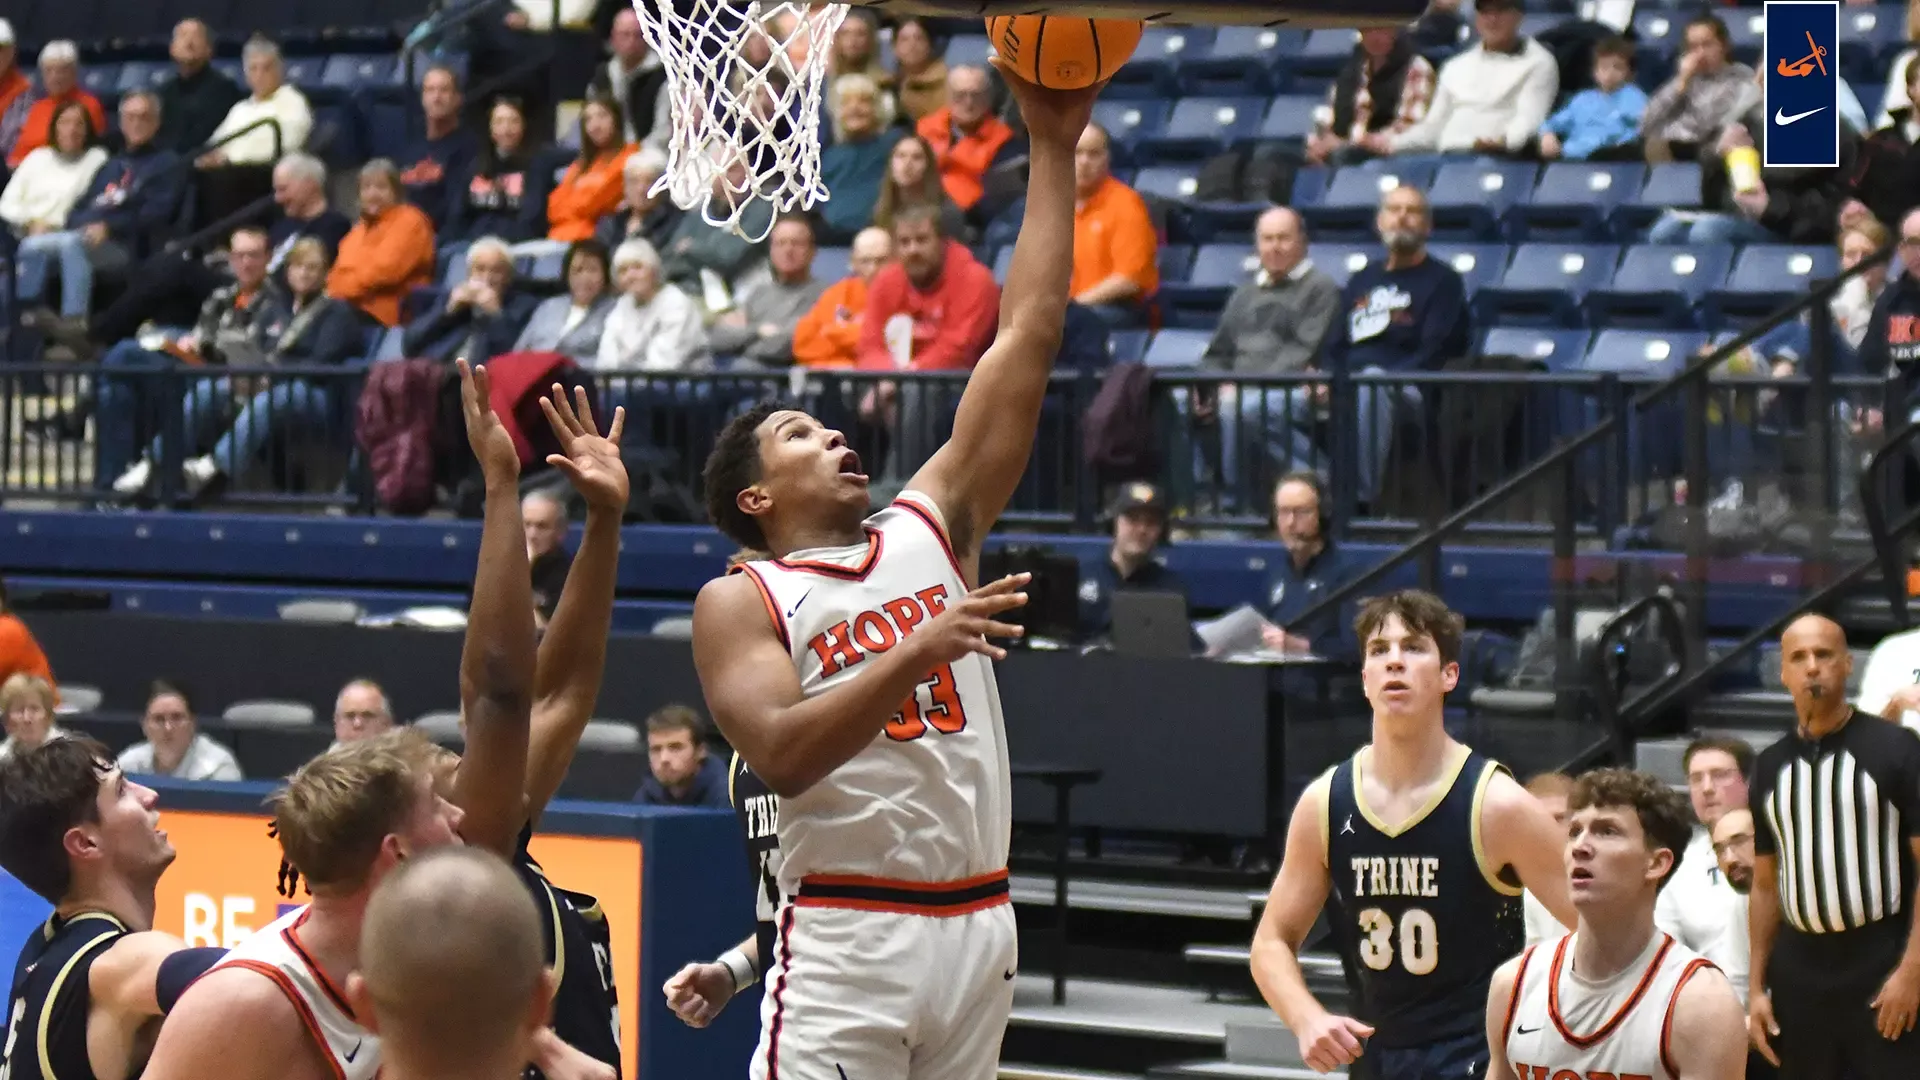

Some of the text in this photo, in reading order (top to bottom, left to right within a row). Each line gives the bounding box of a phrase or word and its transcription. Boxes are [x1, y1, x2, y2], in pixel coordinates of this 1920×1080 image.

[745, 794, 779, 839] TRI
[1351, 857, 1440, 897] TRINE
[1359, 908, 1439, 975] 30
